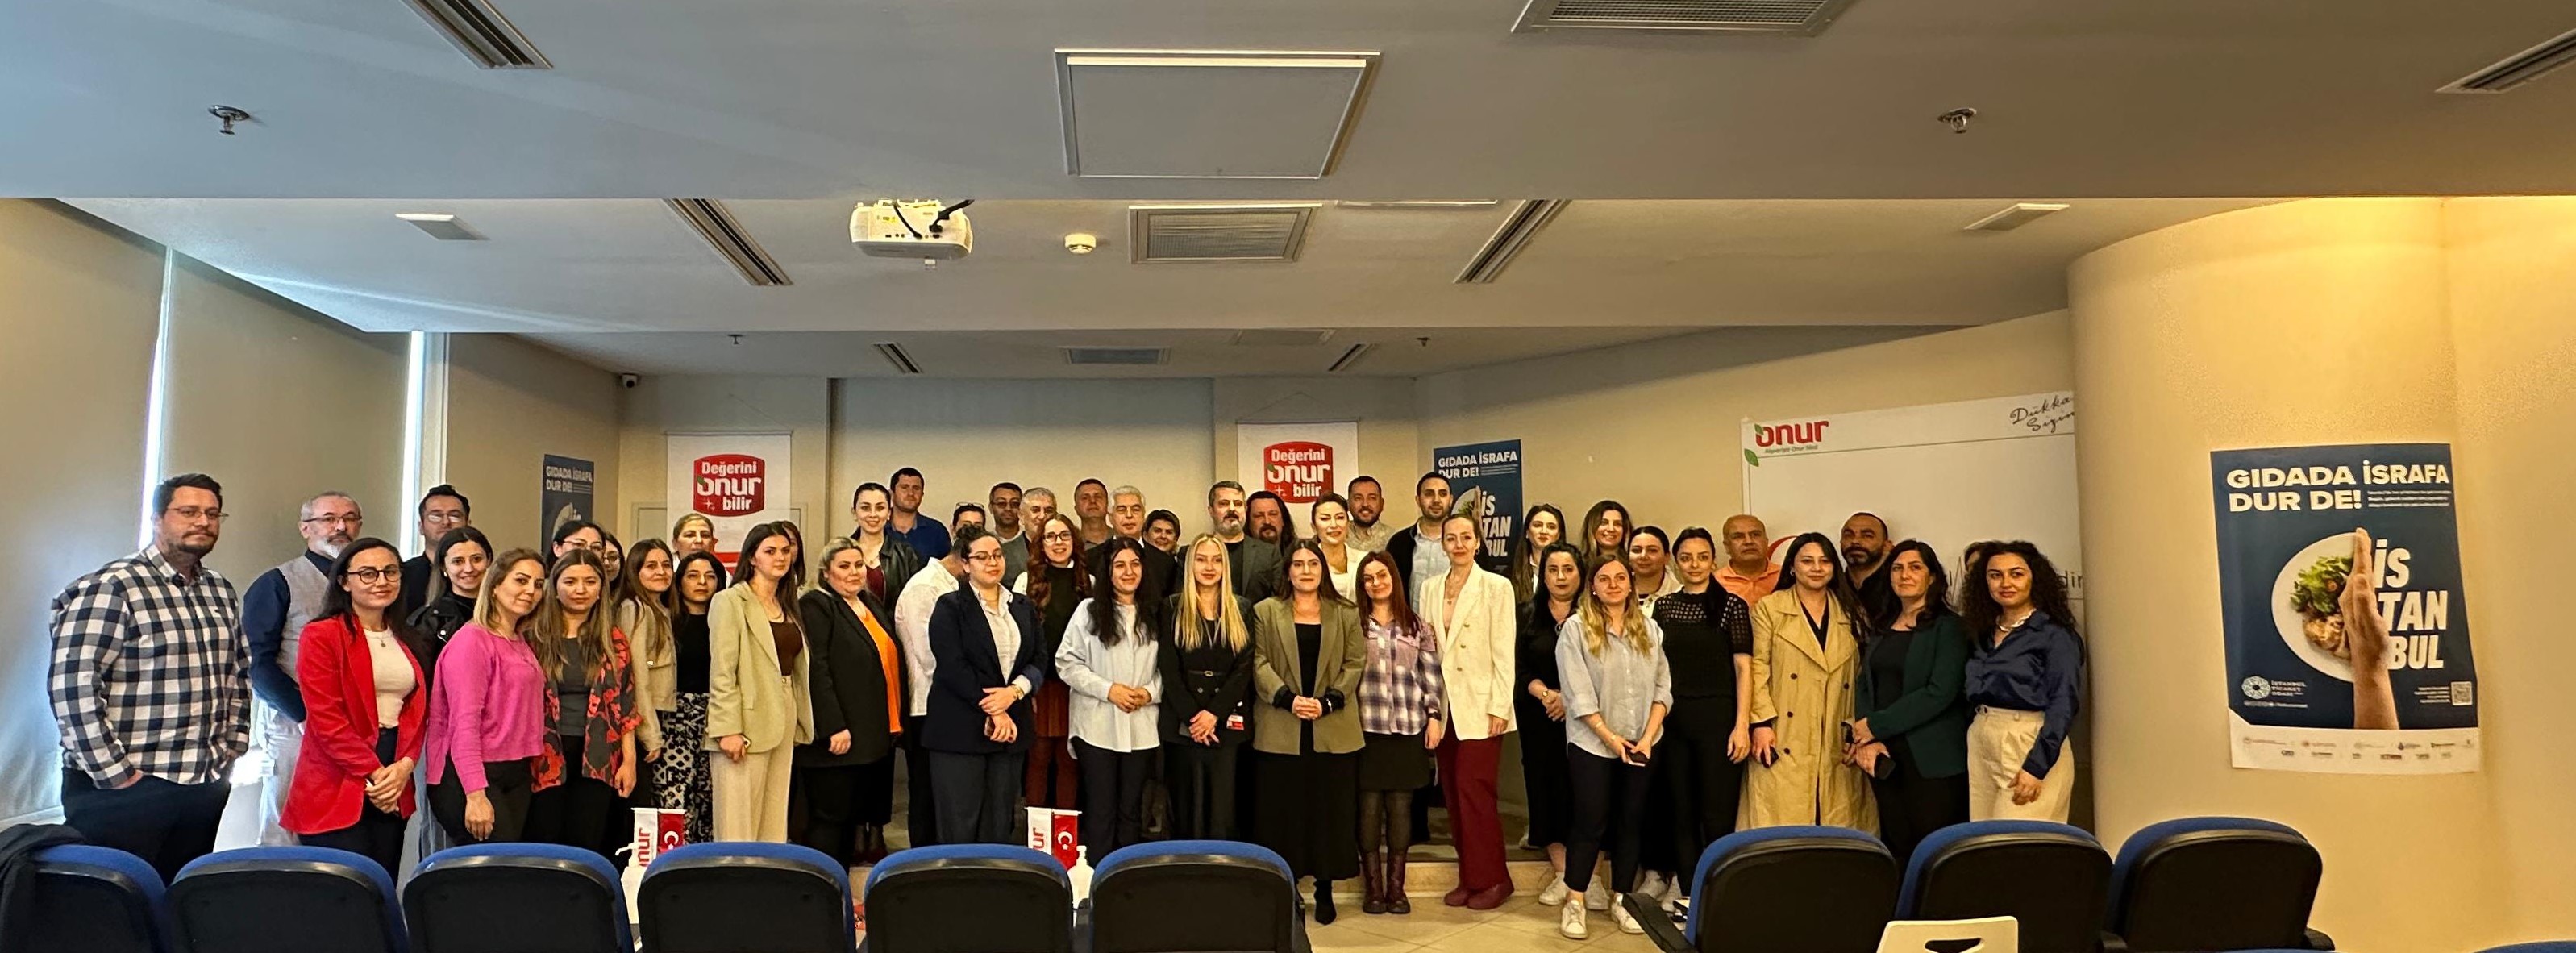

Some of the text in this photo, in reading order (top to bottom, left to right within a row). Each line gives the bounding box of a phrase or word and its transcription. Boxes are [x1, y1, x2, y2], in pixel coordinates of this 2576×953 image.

[2010, 395, 2074, 425] Dükka
[1754, 421, 1829, 447] onur
[1271, 448, 1325, 464] Değerini
[1438, 451, 1518, 468] GIDADA İSRAFA
[546, 466, 572, 479] GIDADA
[701, 461, 757, 476] Değerini
[1267, 464, 1330, 483] onur
[2227, 460, 2450, 488] GIDADA İSRAFA
[546, 479, 561, 492] DUR
[697, 476, 762, 496] onur
[1292, 483, 1322, 497] bilir
[722, 497, 752, 510] bilir
[1481, 490, 1496, 516] İS
[2229, 491, 2301, 512] DUR
[2309, 489, 2362, 510] DE!
[1482, 516, 1512, 538] TAN
[2374, 539, 2411, 589] İS
[2378, 590, 2448, 631] TAN
[2387, 635, 2444, 670] BUL
[638, 827, 651, 868] nur
